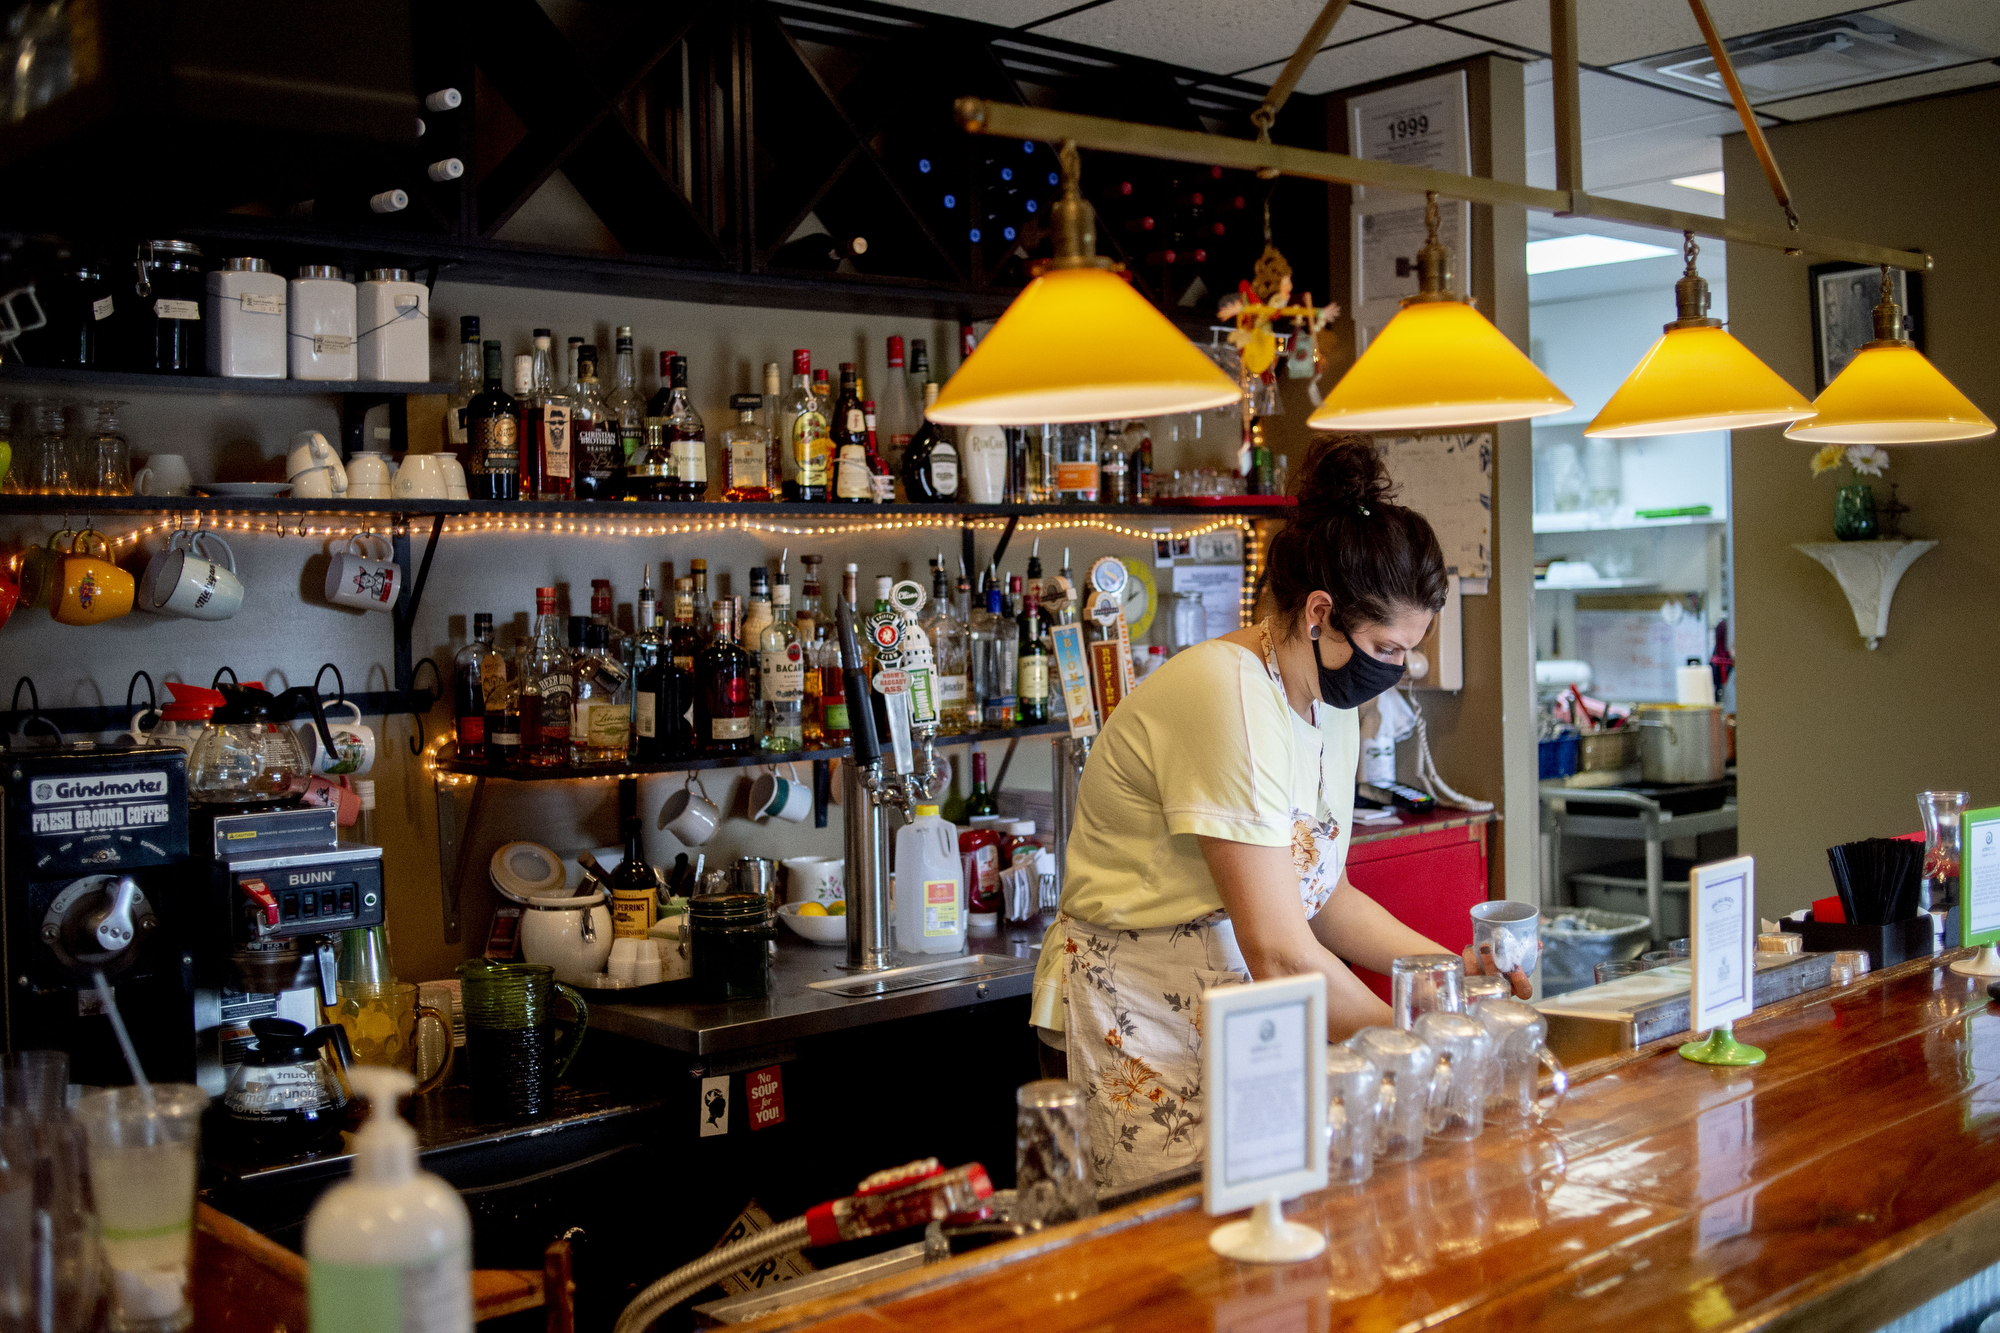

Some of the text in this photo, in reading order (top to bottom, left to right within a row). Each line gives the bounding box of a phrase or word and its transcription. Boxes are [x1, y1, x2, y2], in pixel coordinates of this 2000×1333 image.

[1387, 115, 1429, 140] 1999
[579, 431, 616, 439] CHRISTIAN
[1063, 638, 1081, 705] BLONDE
[1101, 648, 1115, 704] BONFIRE
[538, 674, 558, 690] BEER
[884, 685, 902, 693] ASS
[55, 779, 162, 799] Grindmaster
[32, 804, 169, 833] FRESH GROUND COFFEE
[83, 834, 112, 843] AUTODRIP
[59, 842, 73, 852] DRIP
[140, 840, 166, 857] ESPRESSO
[37, 854, 52, 868] PERC
[289, 871, 332, 886] BUNN
[618, 903, 645, 912] PERRINS
[757, 1072, 772, 1084] No
[751, 1081, 778, 1100] SOUP
[760, 1097, 772, 1110] for
[755, 1106, 779, 1123] YOU!
